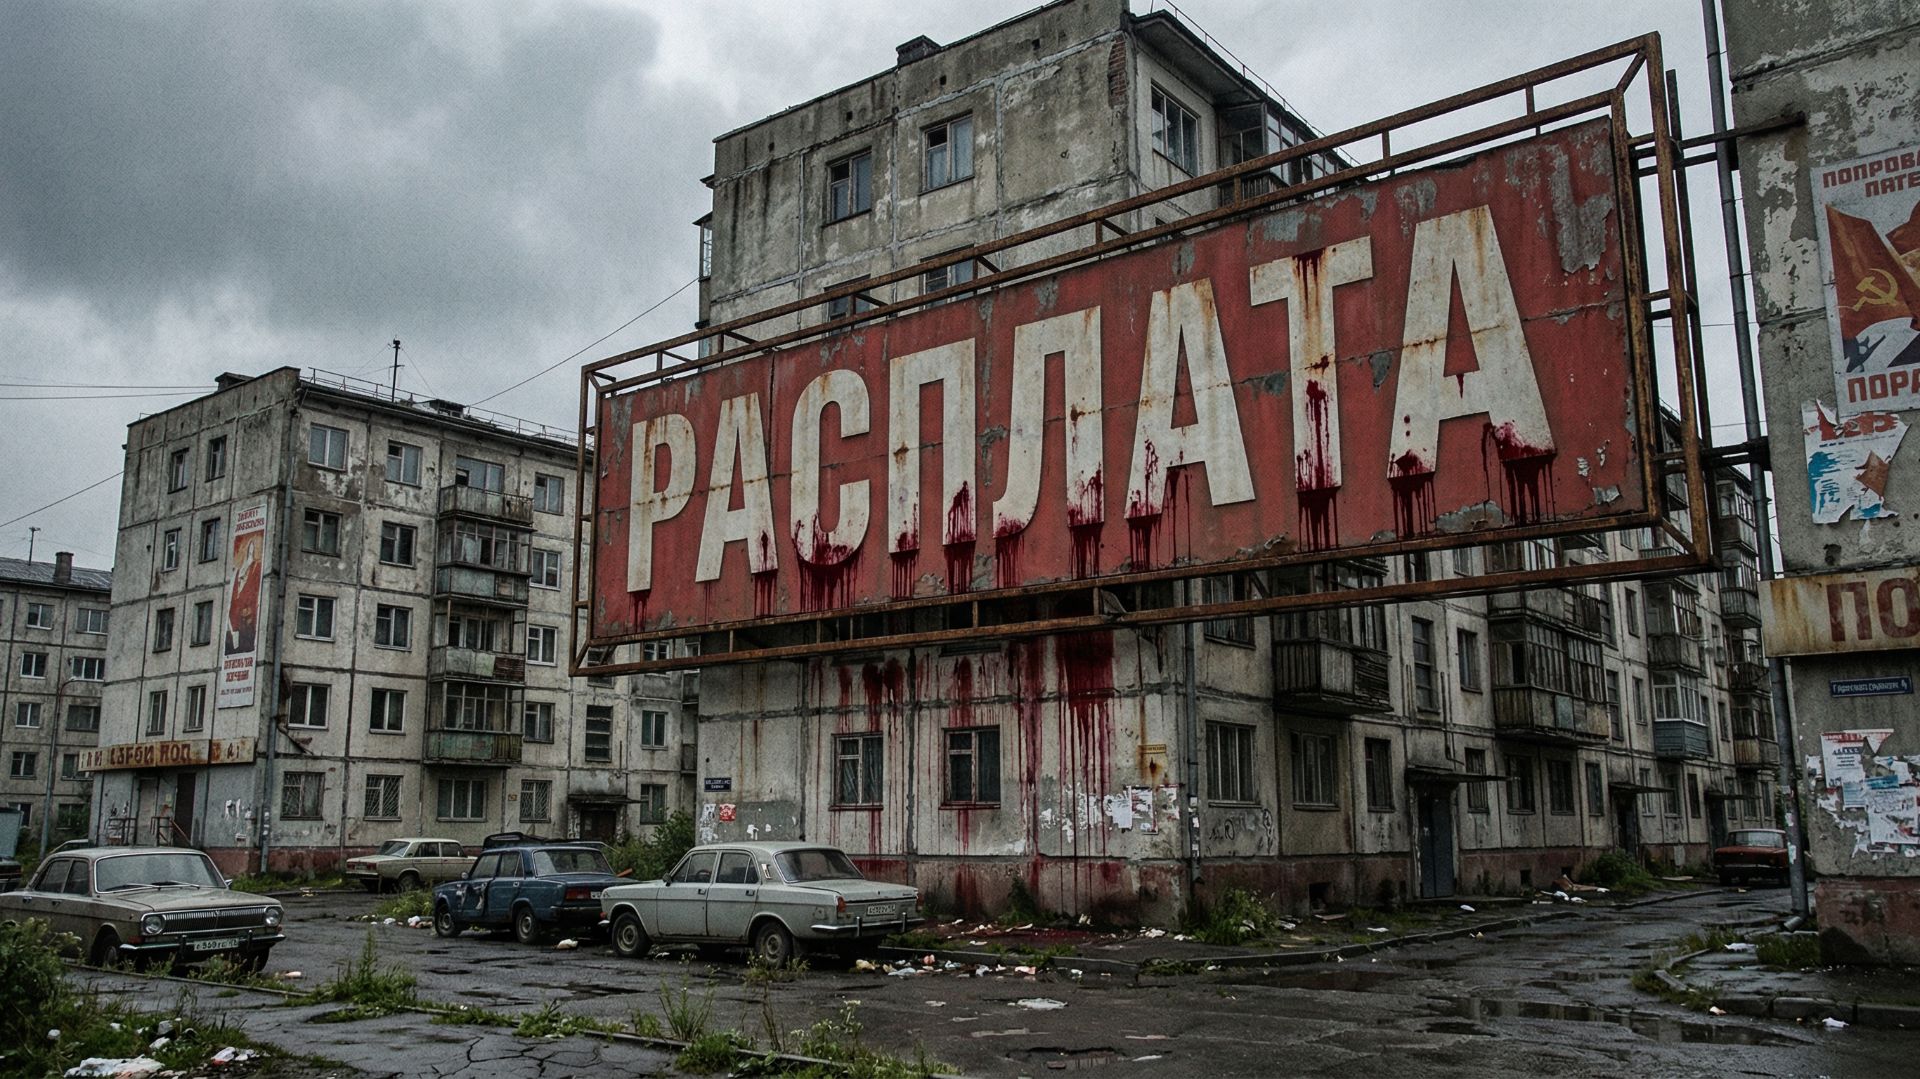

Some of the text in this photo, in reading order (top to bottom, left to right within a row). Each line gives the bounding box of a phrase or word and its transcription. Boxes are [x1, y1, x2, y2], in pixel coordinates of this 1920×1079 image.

[1823, 150, 1920, 188] ПОПРОВ
[627, 204, 1556, 592] РАСПЛАТА
[1826, 577, 1920, 642] ПО
